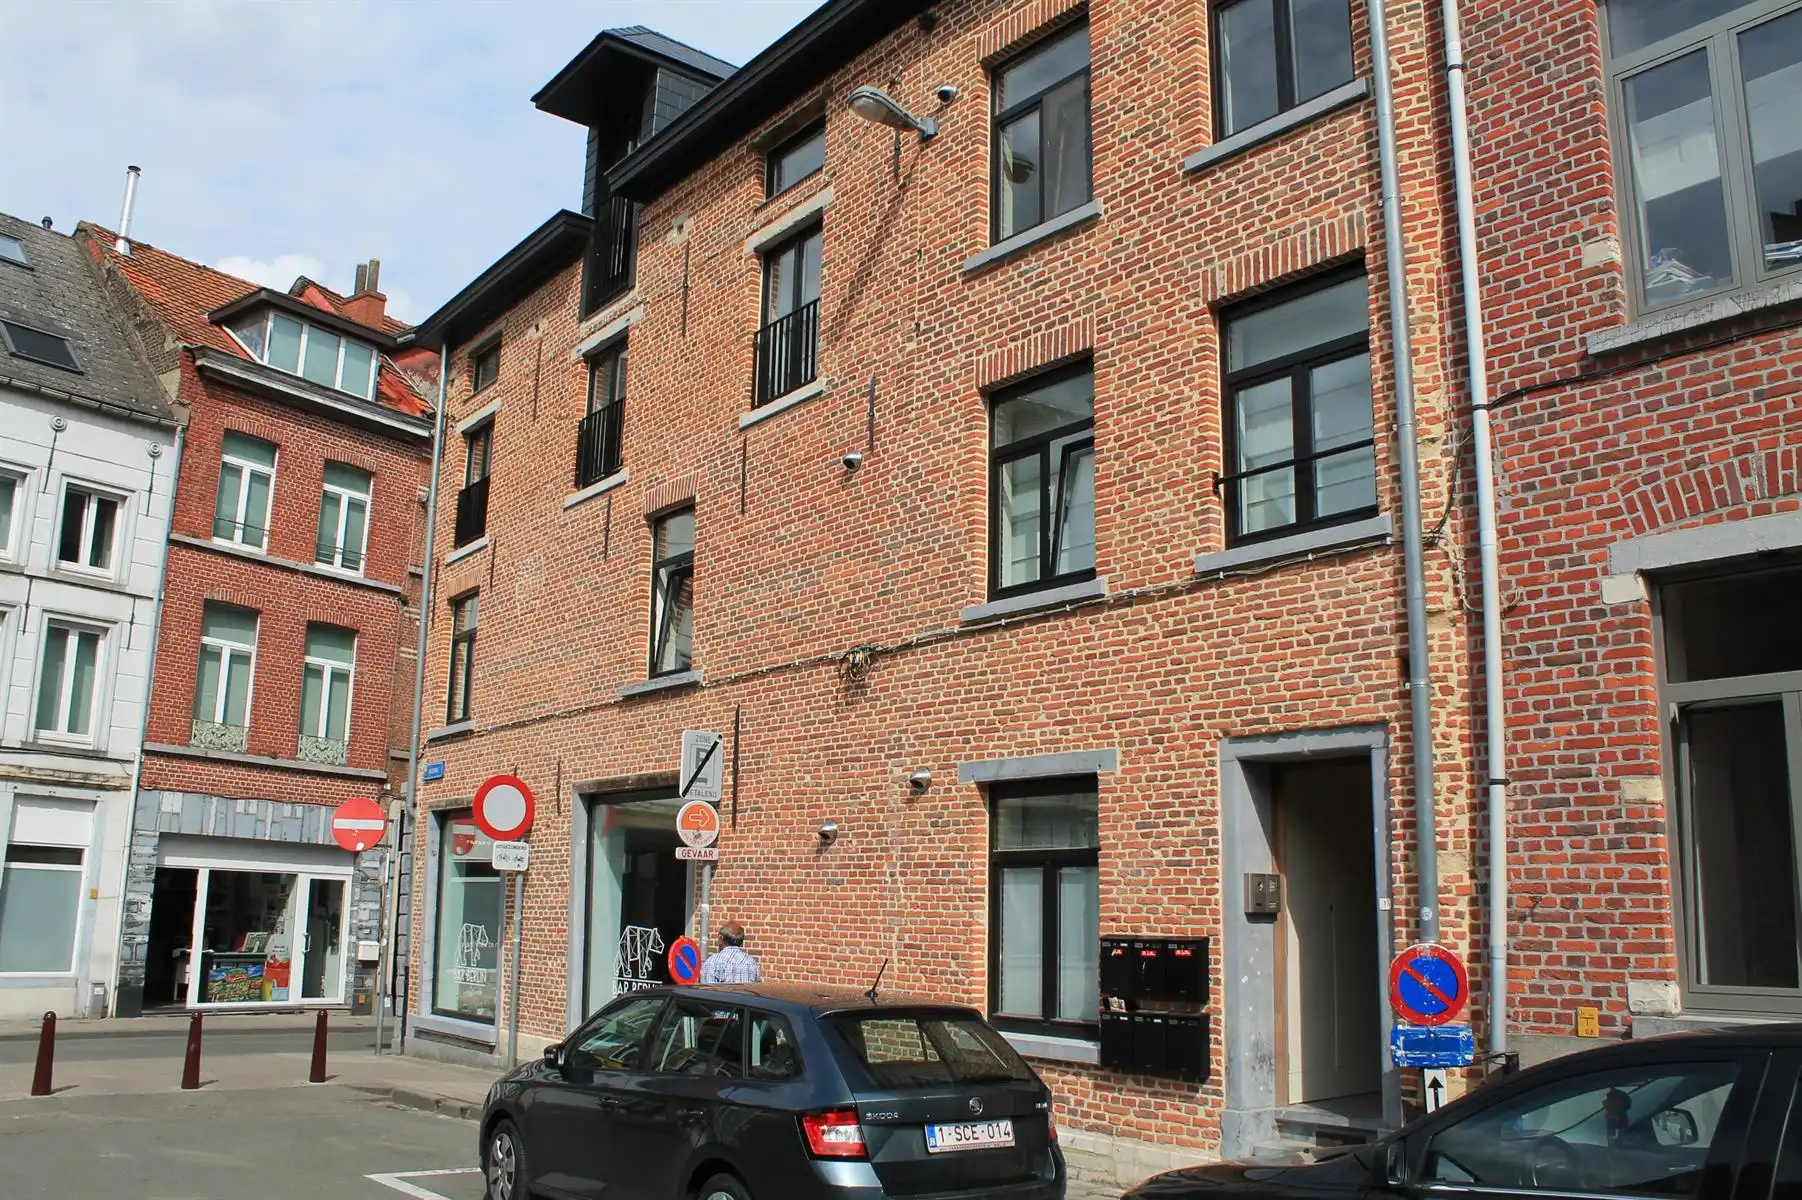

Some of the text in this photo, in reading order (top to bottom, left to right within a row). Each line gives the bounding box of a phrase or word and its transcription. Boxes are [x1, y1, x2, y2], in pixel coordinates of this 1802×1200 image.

[695, 734, 712, 744] ZONE
[687, 789, 718, 799] ETALEND
[681, 849, 714, 858] GEVAAR
